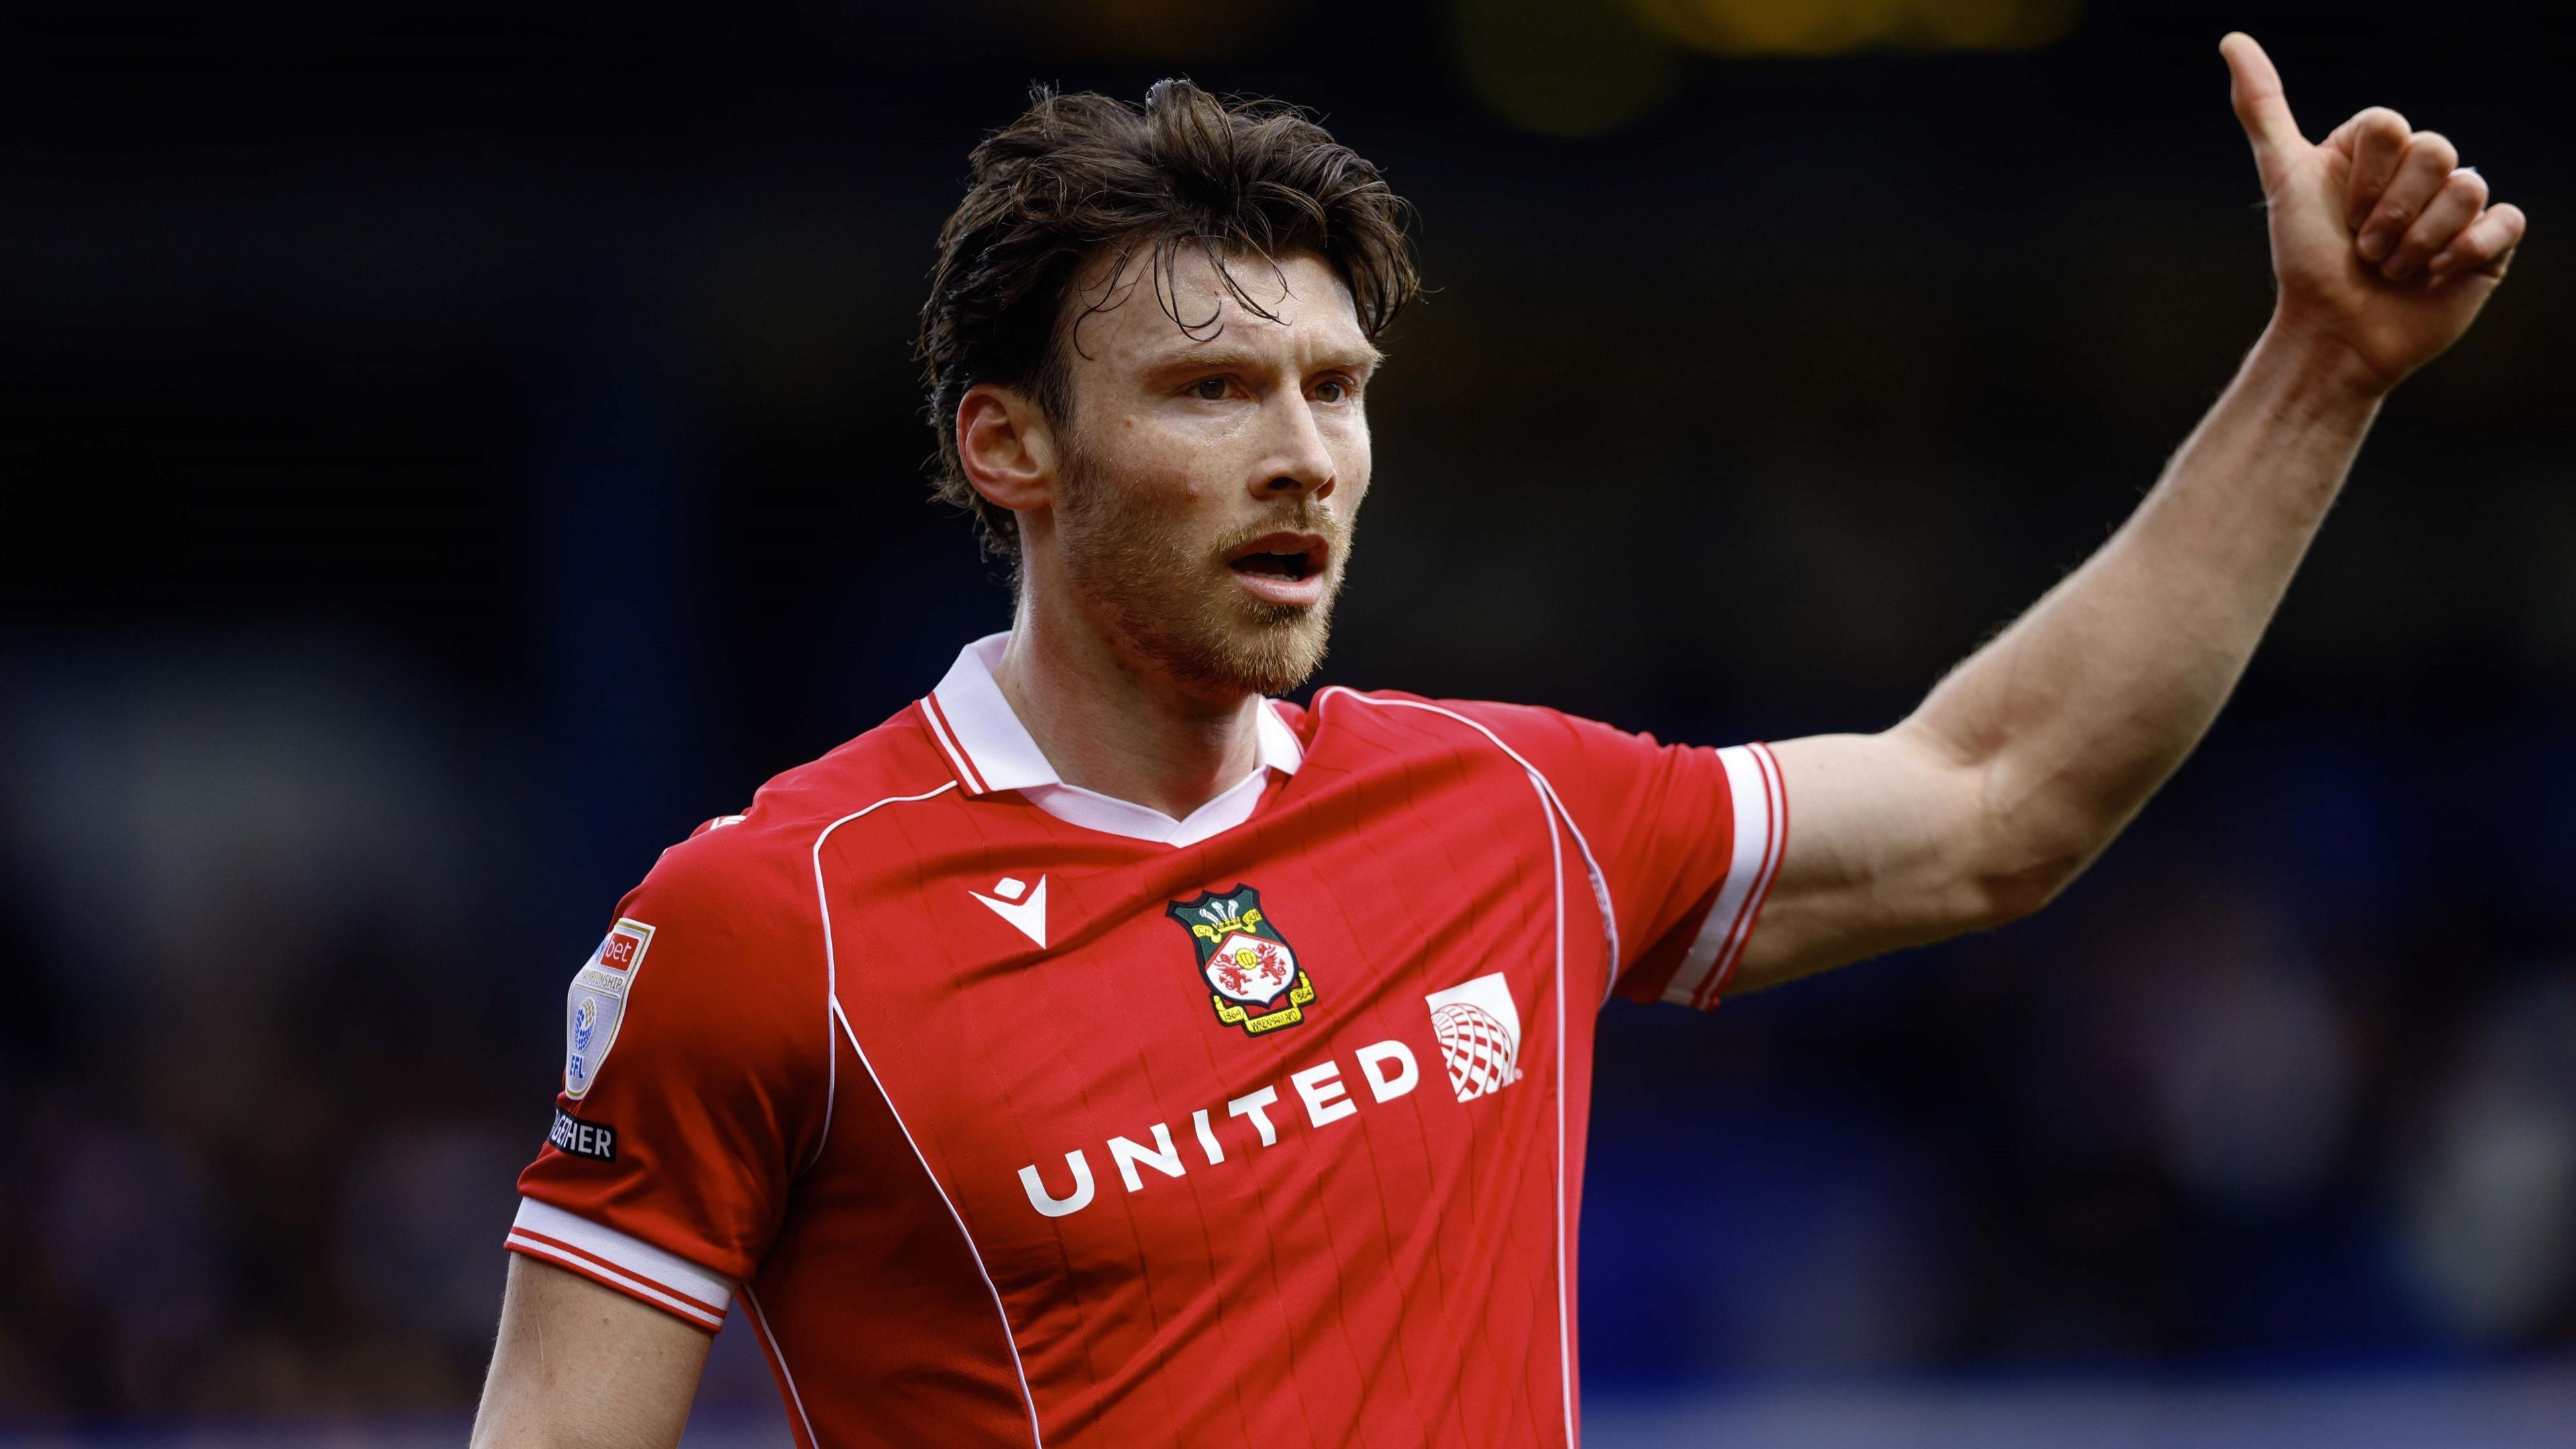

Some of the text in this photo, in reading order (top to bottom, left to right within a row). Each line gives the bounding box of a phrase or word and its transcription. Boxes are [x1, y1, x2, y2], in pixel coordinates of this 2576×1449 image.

[605, 935, 632, 962] bet
[1223, 1009, 1242, 1021] 1864
[570, 1054, 584, 1079] EFL
[1017, 1039, 1419, 1218] UNITED
